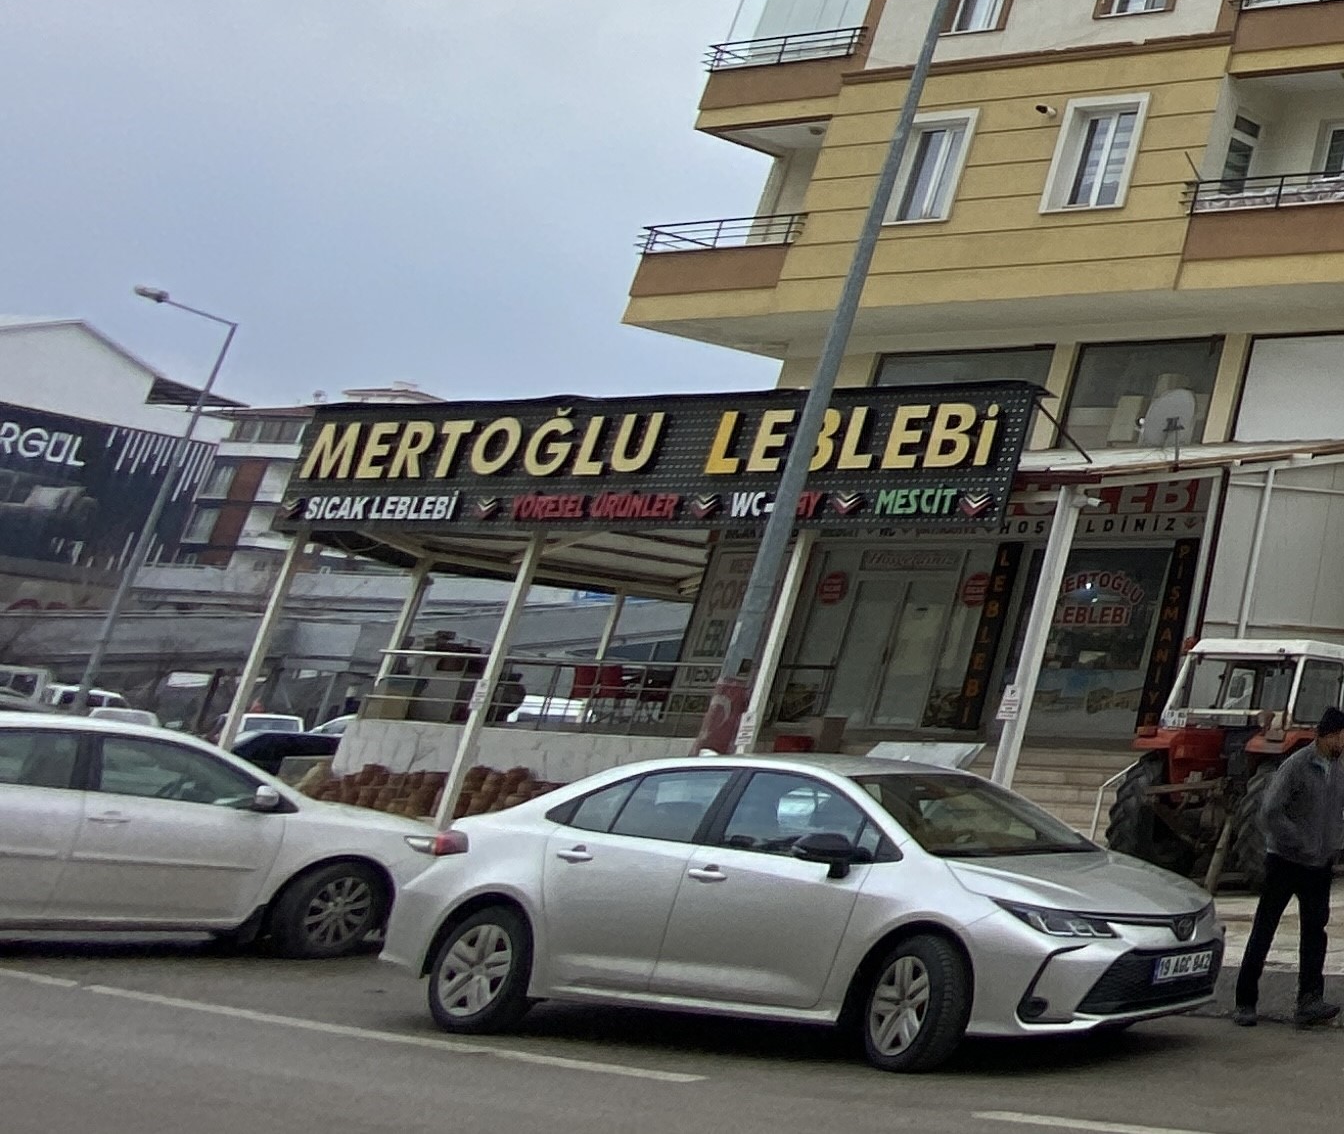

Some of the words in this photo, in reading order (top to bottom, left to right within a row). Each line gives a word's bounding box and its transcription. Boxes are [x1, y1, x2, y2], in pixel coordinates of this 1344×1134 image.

[300, 405, 665, 479] MERTOĞLU
[305, 495, 370, 520] SICAK
[1060, 569, 1145, 605] ERTOĞLU
